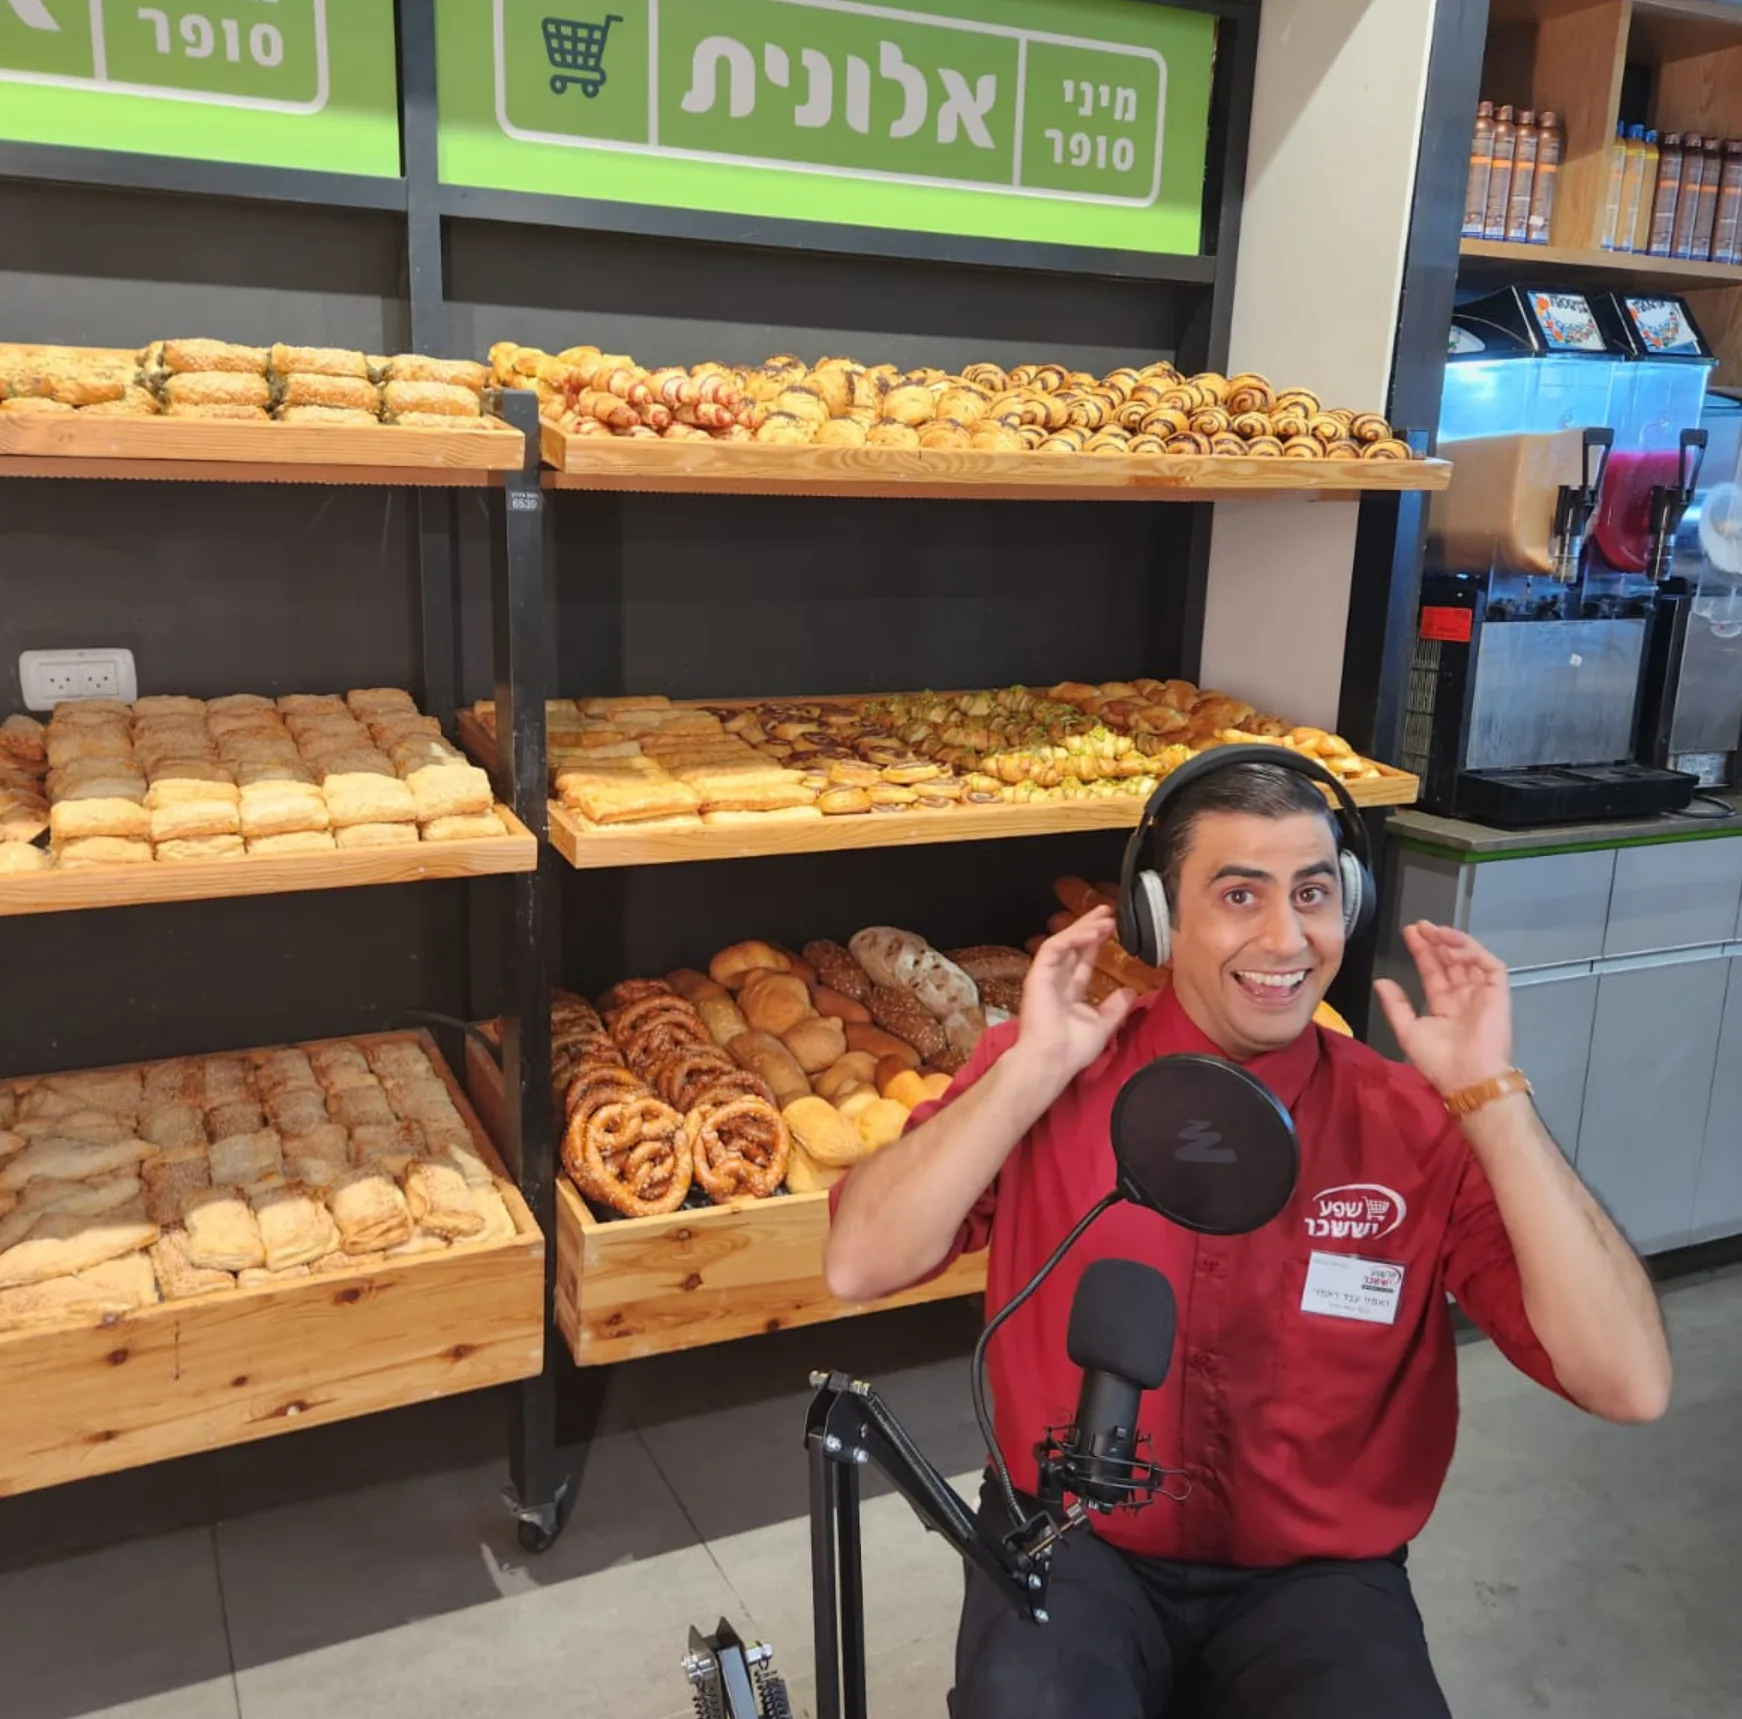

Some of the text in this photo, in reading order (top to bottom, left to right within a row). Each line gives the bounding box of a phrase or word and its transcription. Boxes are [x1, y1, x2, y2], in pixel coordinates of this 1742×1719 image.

[138, 9, 284, 67] סופר
[681, 36, 997, 149] אלונית
[1063, 79, 1137, 122] מיני
[1044, 129, 1135, 172] סופר
[1304, 1217, 1379, 1239] יששכר
[1320, 1200, 1363, 1218] שפע
